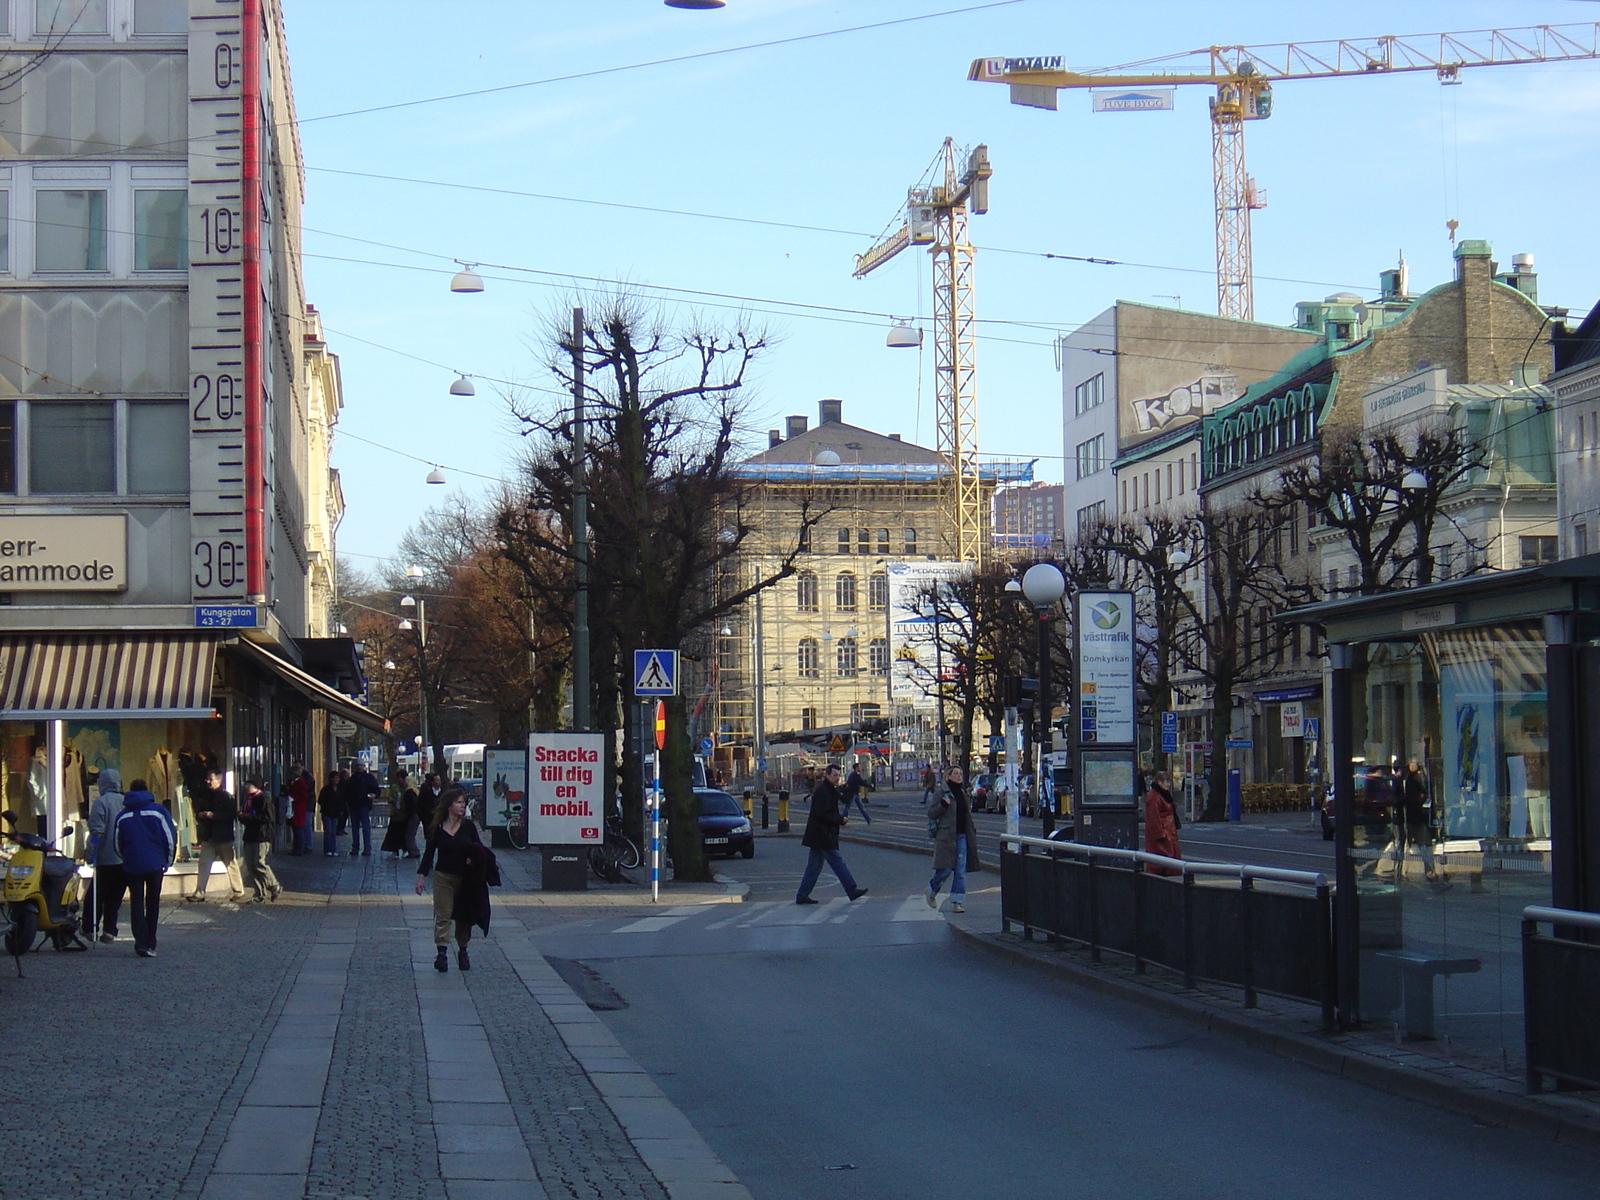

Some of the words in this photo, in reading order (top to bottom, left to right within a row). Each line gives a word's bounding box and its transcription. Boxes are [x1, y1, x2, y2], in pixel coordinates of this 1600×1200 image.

[214, 42, 233, 89] 0
[1004, 55, 1062, 70] POTAIN
[1102, 100, 1131, 109] TUVE
[1133, 99, 1164, 108] BYGG
[200, 207, 233, 255] 10
[192, 373, 235, 422] 20
[194, 540, 236, 588] 30
[201, 608, 252, 618] Kungsgatan
[201, 617, 214, 626] 43
[220, 617, 232, 626] 27
[1083, 632, 1130, 642] västtrafik
[1083, 655, 1130, 665] Domkyrkan
[1089, 672, 1095, 681] 1
[1089, 684, 1096, 694] 6
[1085, 708, 1096, 717] 16
[1166, 713, 1175, 724] P
[534, 746, 599, 763] Snacka
[540, 766, 563, 782] till
[566, 766, 593, 785] dig
[556, 785, 577, 798] en
[540, 801, 593, 816] mobil.
